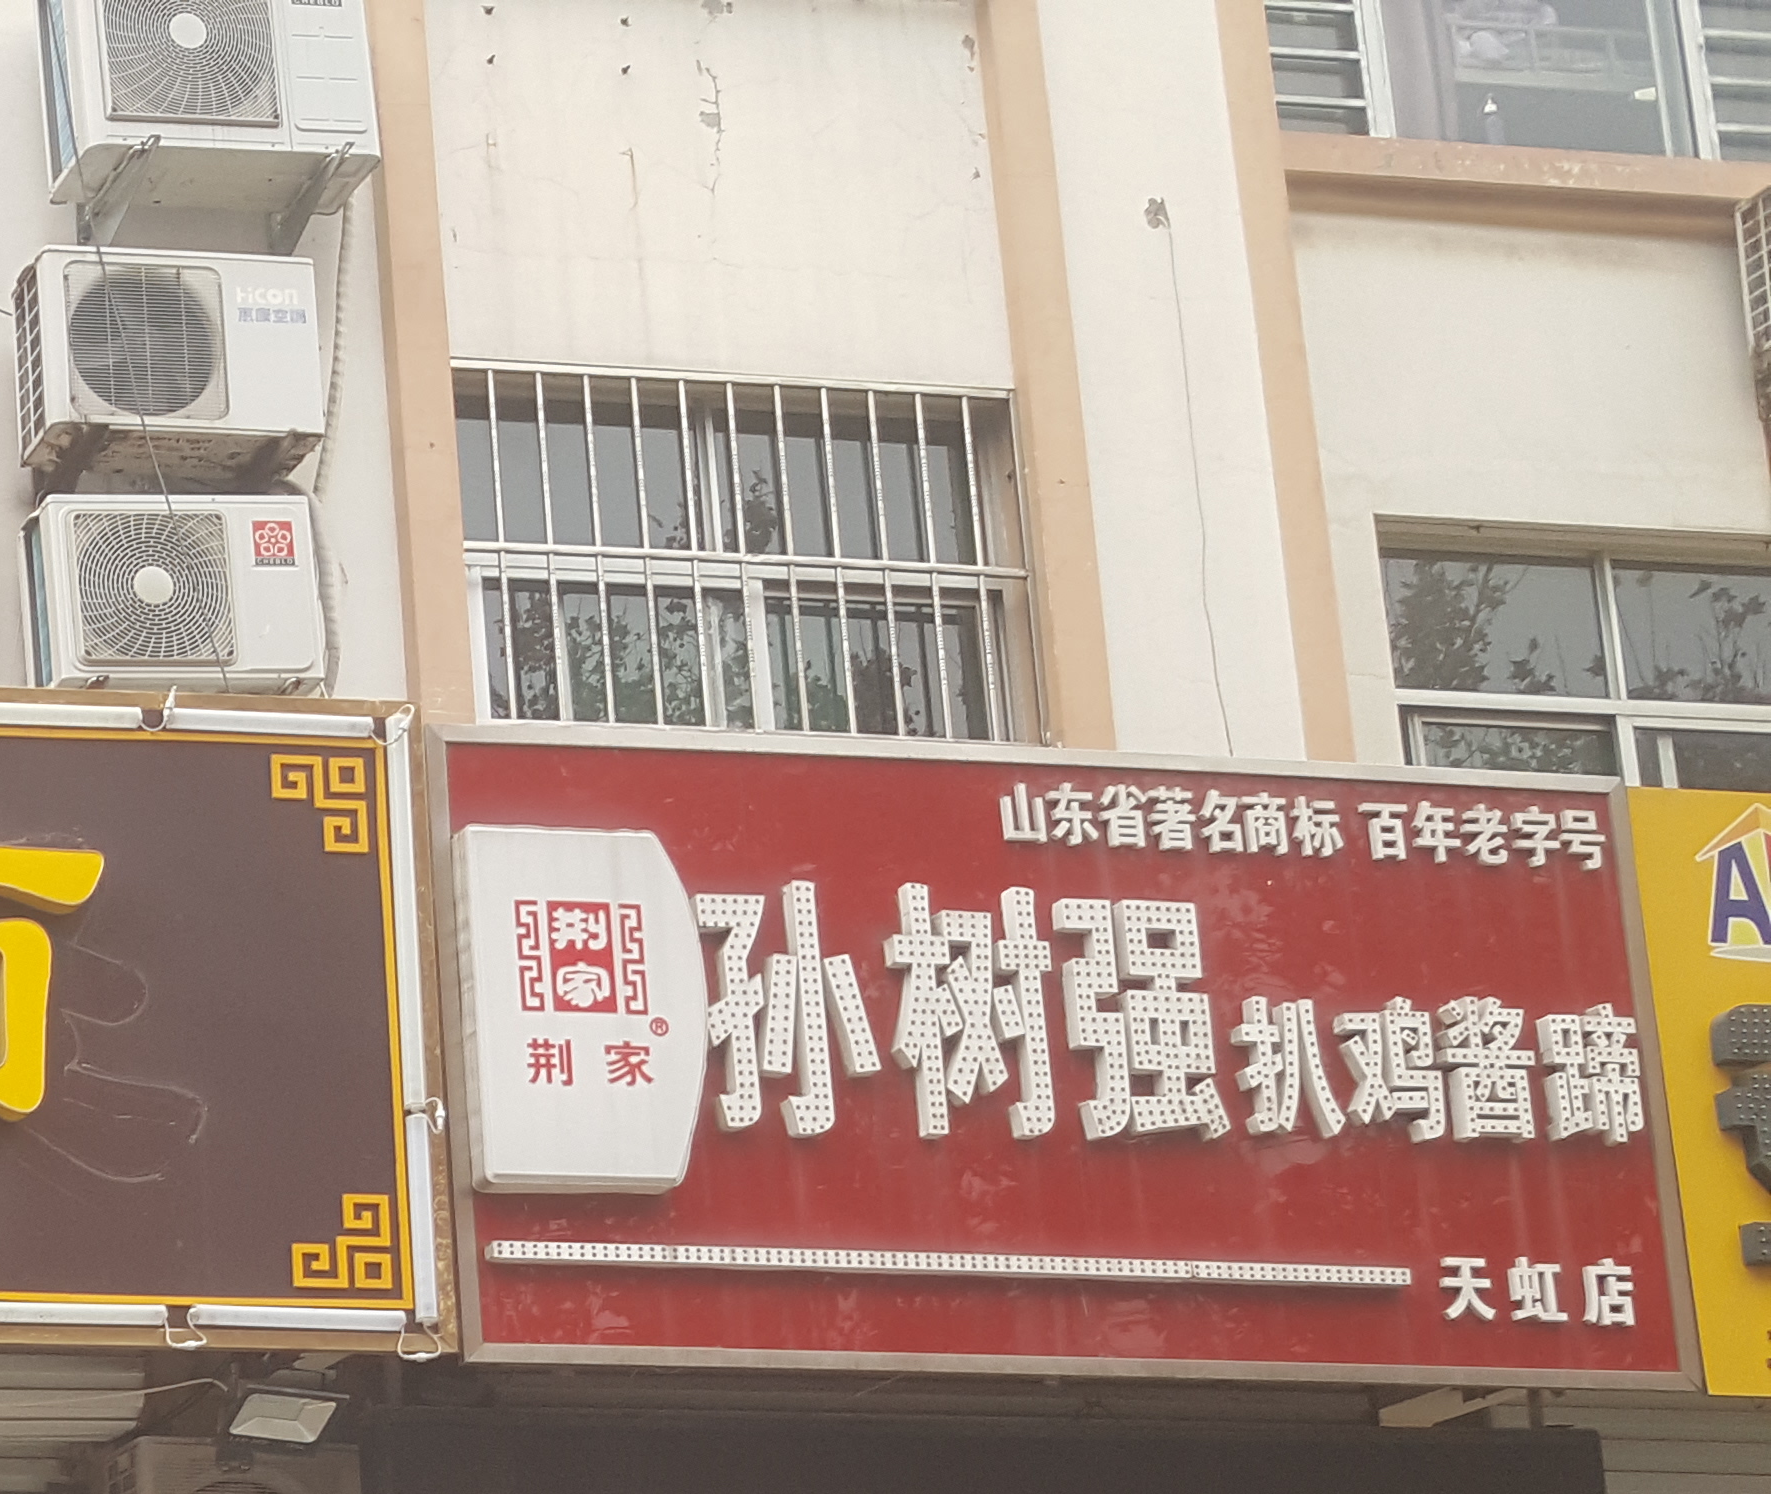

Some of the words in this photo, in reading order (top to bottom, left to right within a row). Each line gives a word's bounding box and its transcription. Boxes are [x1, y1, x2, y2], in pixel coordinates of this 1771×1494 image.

[1000, 782, 1344, 860] 山东省著名商标
[1359, 801, 1607, 872] 百年老字号
[691, 879, 1230, 1143] 孙树强
[527, 1037, 655, 1087] 荆家
[1439, 1255, 1638, 1328] 天虹店
